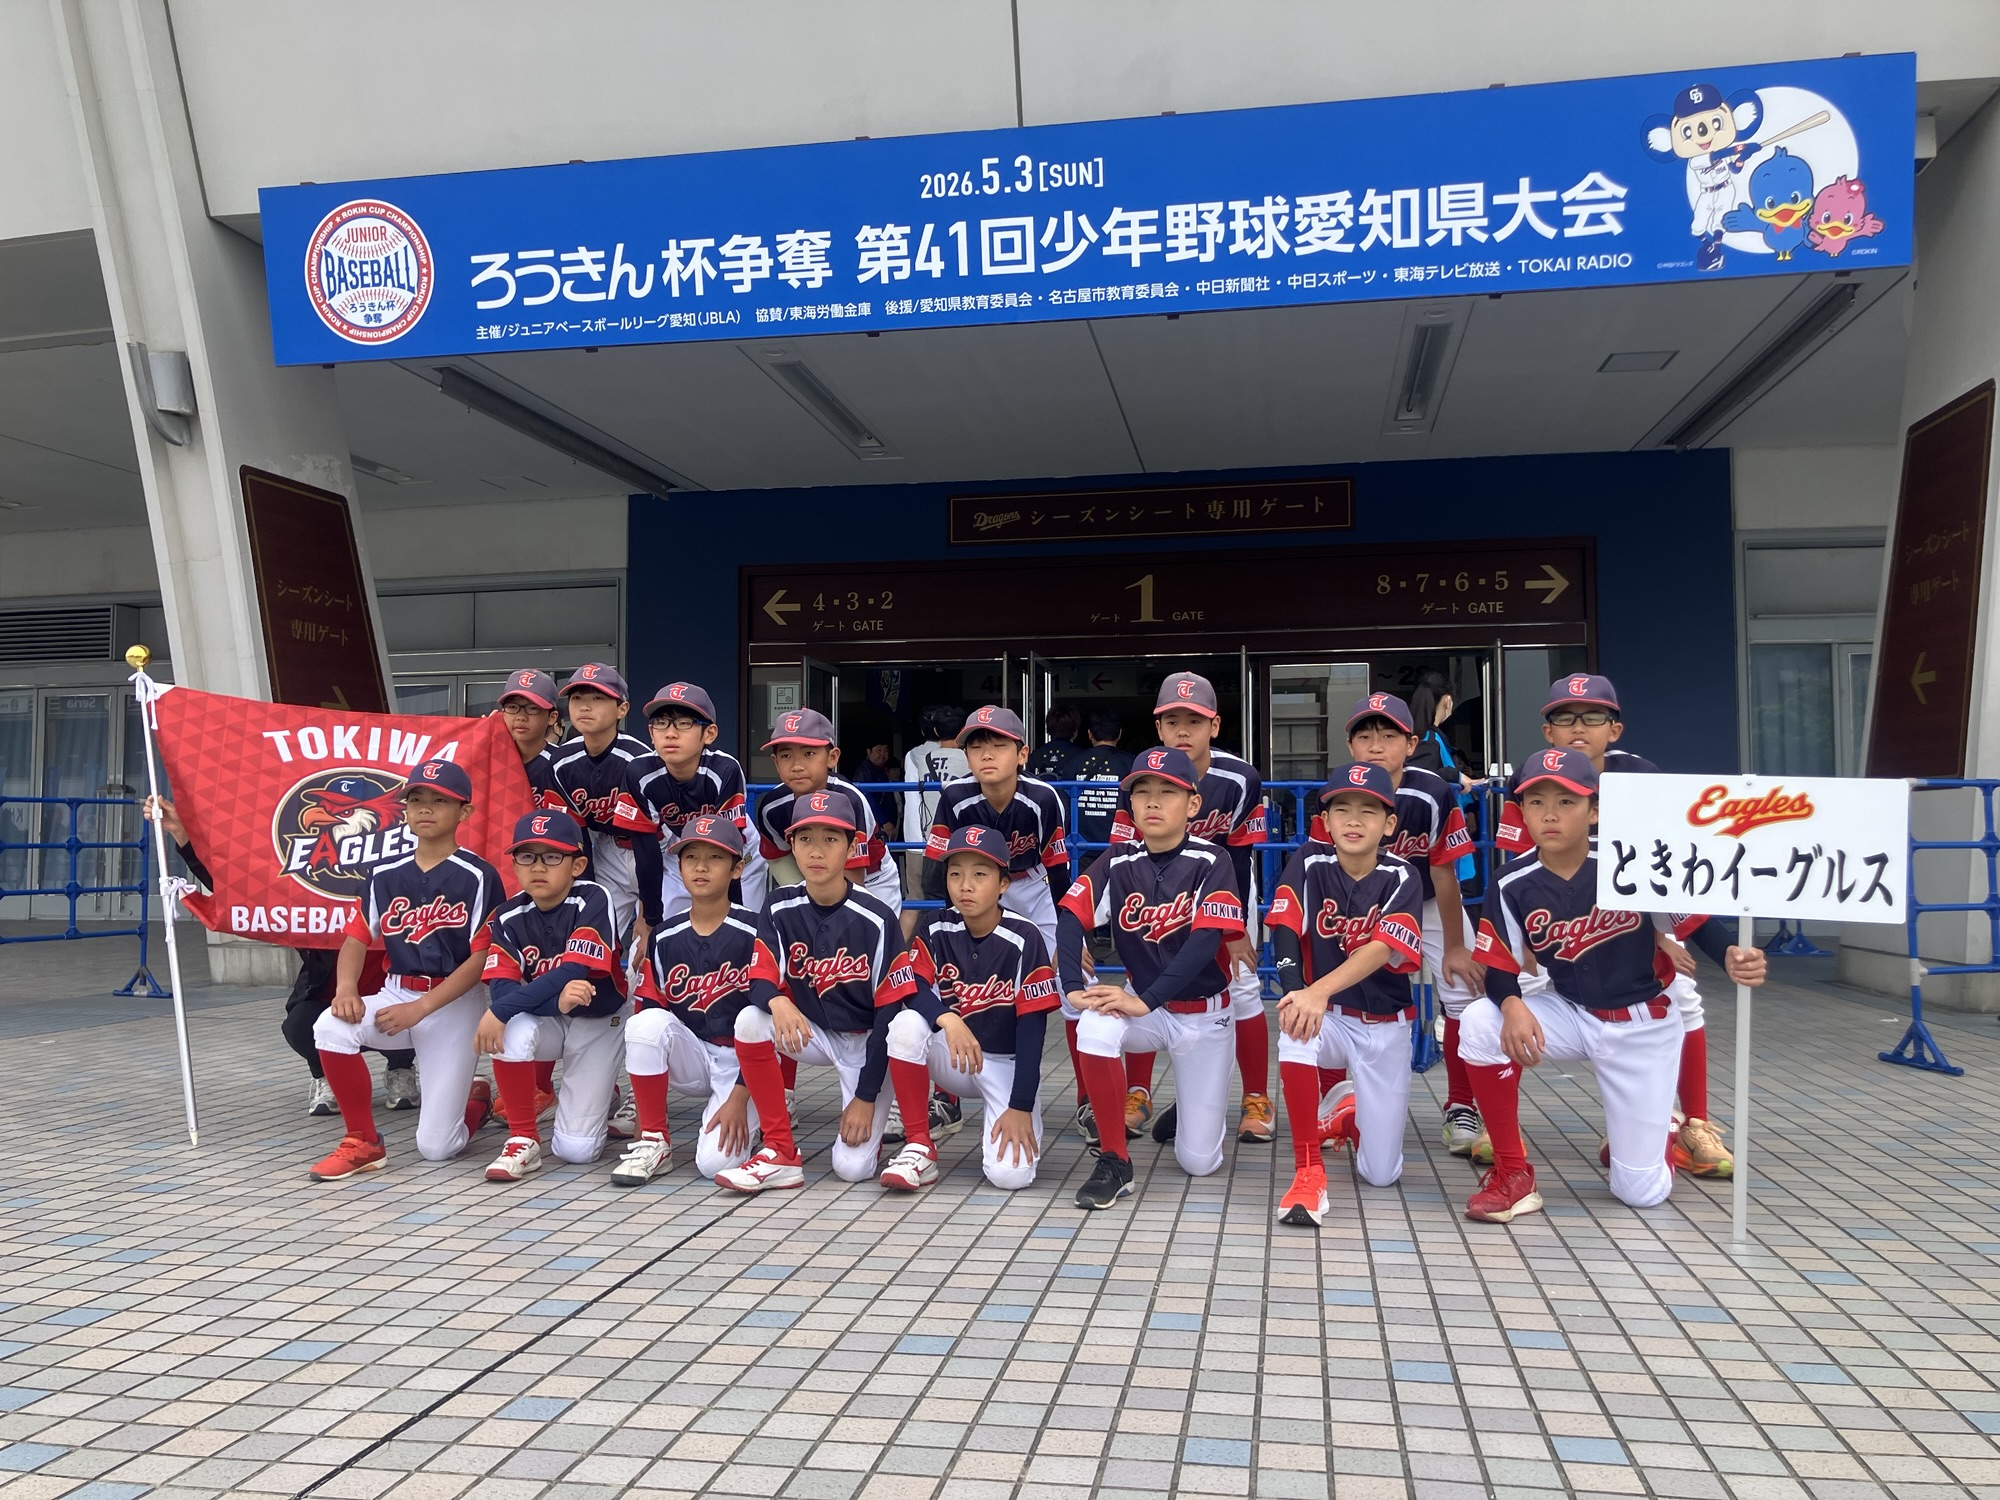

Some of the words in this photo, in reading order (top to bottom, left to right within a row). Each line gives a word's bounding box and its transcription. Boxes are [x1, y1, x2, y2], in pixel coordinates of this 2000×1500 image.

[341, 206, 367, 219] ROKIN
[368, 206, 386, 216] CUP
[386, 211, 428, 265] CHAMPIONSHIP
[344, 225, 388, 244] JUNIOR
[856, 171, 1629, 284] 第41回少年野球愛知県大会
[310, 221, 334, 284] CHAMPIONSHIP
[1577, 253, 1633, 272] RADIO
[322, 244, 416, 301] BASEBALL
[312, 285, 324, 303] CUP
[350, 300, 396, 313] ろうきん杯
[415, 276, 429, 305] ROKIN
[320, 303, 342, 328] ROKIN
[349, 319, 407, 338] CHAMPIONSHIP
[363, 313, 383, 325] 争奪
[406, 304, 420, 322] CUP
[973, 509, 1021, 532] Dragons
[1030, 496, 1325, 527] シーズンシート専用ゲート
[276, 579, 354, 612] シーズンシート
[1089, 611, 1121, 625] ゲート
[1123, 574, 1165, 623] 1
[1172, 610, 1205, 621] GATE
[1421, 602, 1459, 616] ゲート
[1468, 601, 1504, 615] GATE
[291, 619, 348, 647] 専用ゲート
[812, 619, 845, 633] ゲート
[853, 619, 884, 632] GATE
[571, 787, 619, 824] Eagl
[1686, 784, 1815, 839] Eagles
[1245, 816, 1266, 834] TOKI
[287, 825, 419, 875] EAGLES
[1611, 838, 1893, 907] ときわイーグルス
[231, 905, 346, 934] BASEBA
[380, 894, 468, 944] Eagles
[1118, 891, 1195, 944] Eagle
[1316, 898, 1383, 955] Eagl
[1525, 904, 1642, 962] Eagles
[1379, 919, 1422, 954] TOKIWA
[787, 941, 871, 998] Eagles
[888, 965, 915, 989] TOKI
[665, 961, 750, 1013] Eagles
[1022, 977, 1058, 1001] TOKIW
